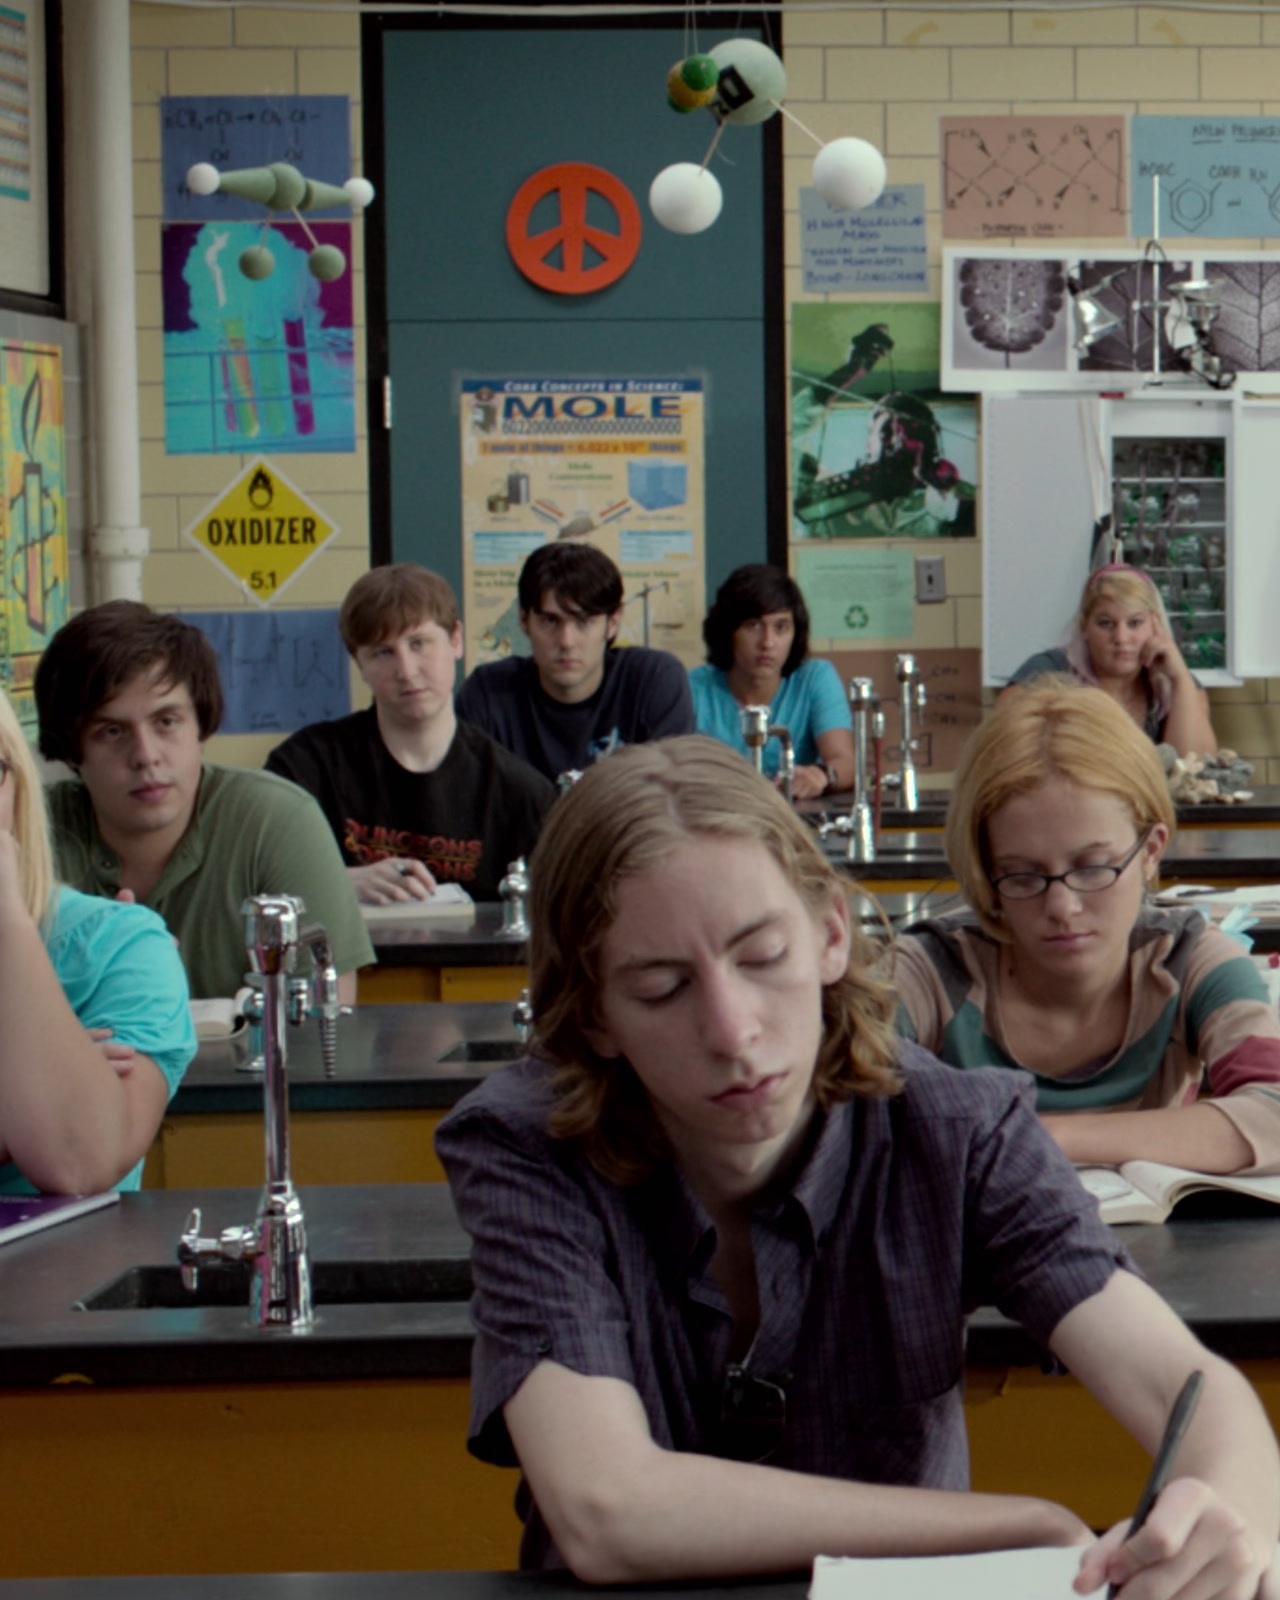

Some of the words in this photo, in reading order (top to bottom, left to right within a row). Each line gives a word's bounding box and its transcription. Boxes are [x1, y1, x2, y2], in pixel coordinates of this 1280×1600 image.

[541, 381, 605, 391] CONCEPTS
[503, 396, 682, 419] MOLE
[207, 518, 316, 546] OXIDIZER
[250, 571, 277, 589] 5.1
[345, 818, 482, 859] DUNGEONS
